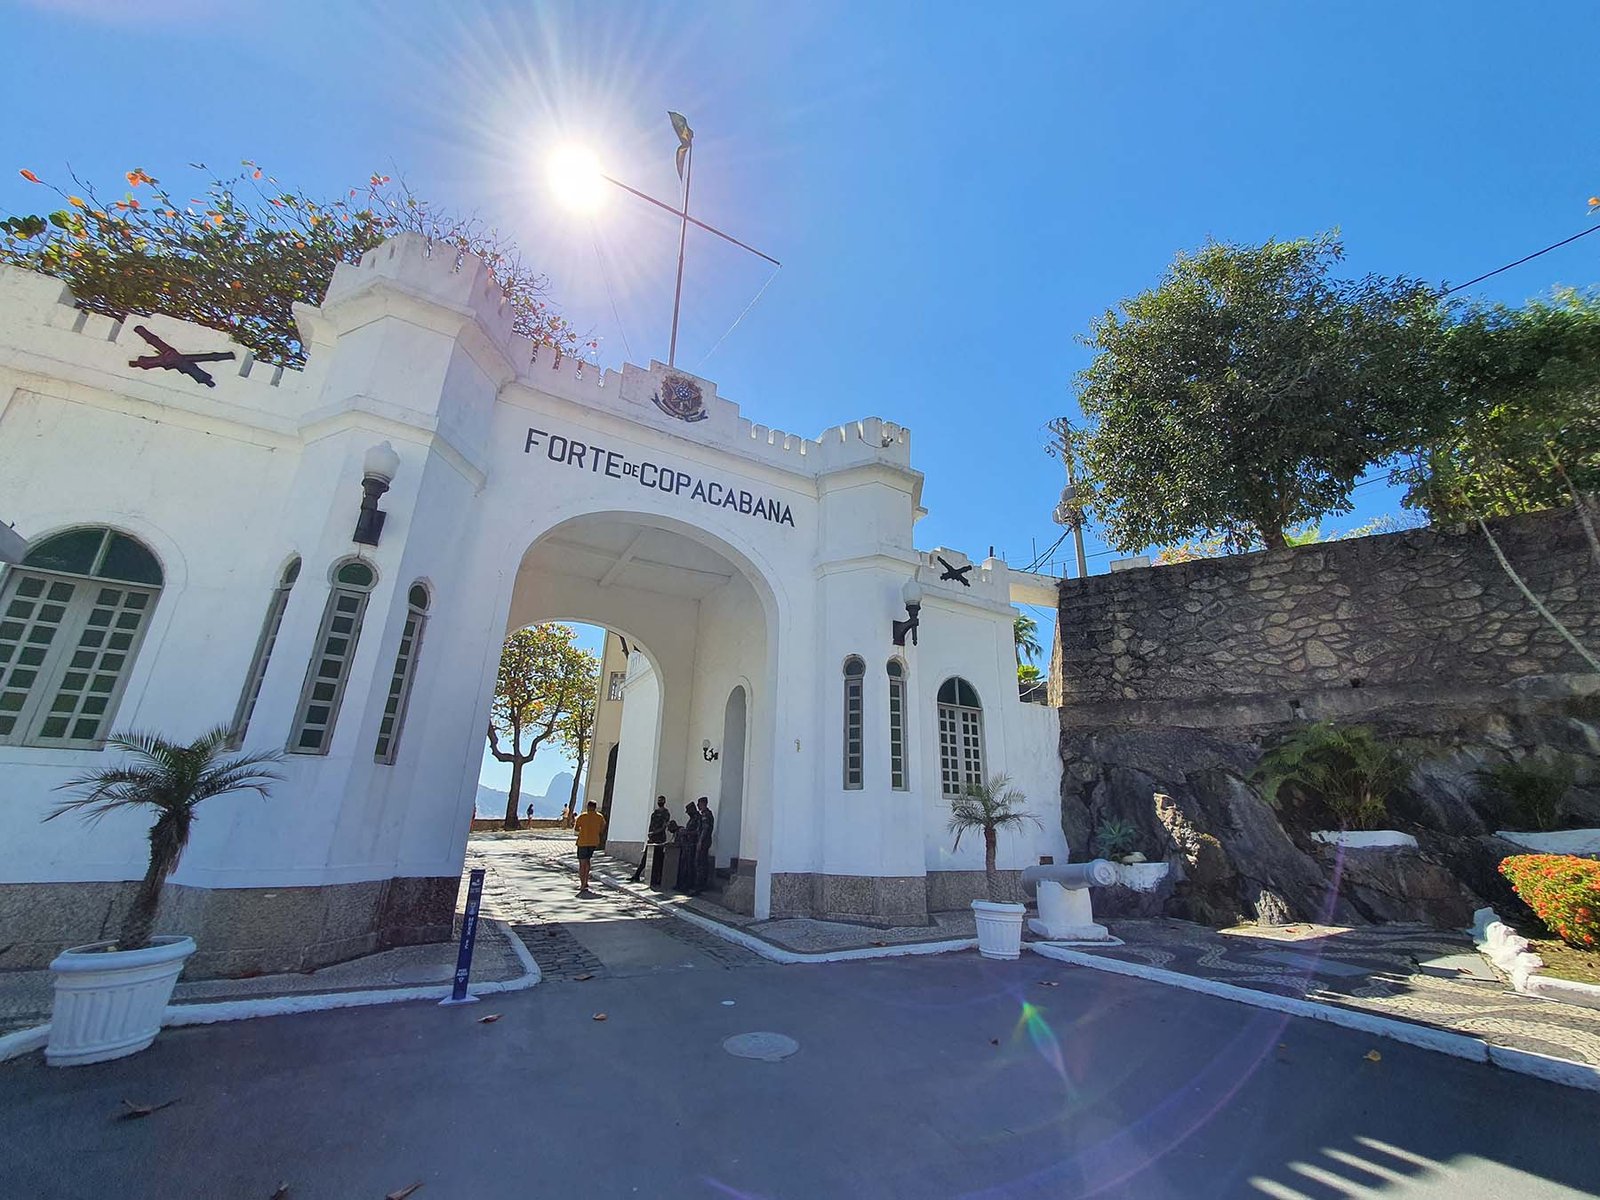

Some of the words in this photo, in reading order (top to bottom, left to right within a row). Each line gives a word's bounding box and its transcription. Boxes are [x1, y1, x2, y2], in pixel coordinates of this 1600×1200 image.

[524, 428, 624, 479] FORTE
[623, 462, 640, 478] DE
[639, 462, 795, 527] COPACABANA
